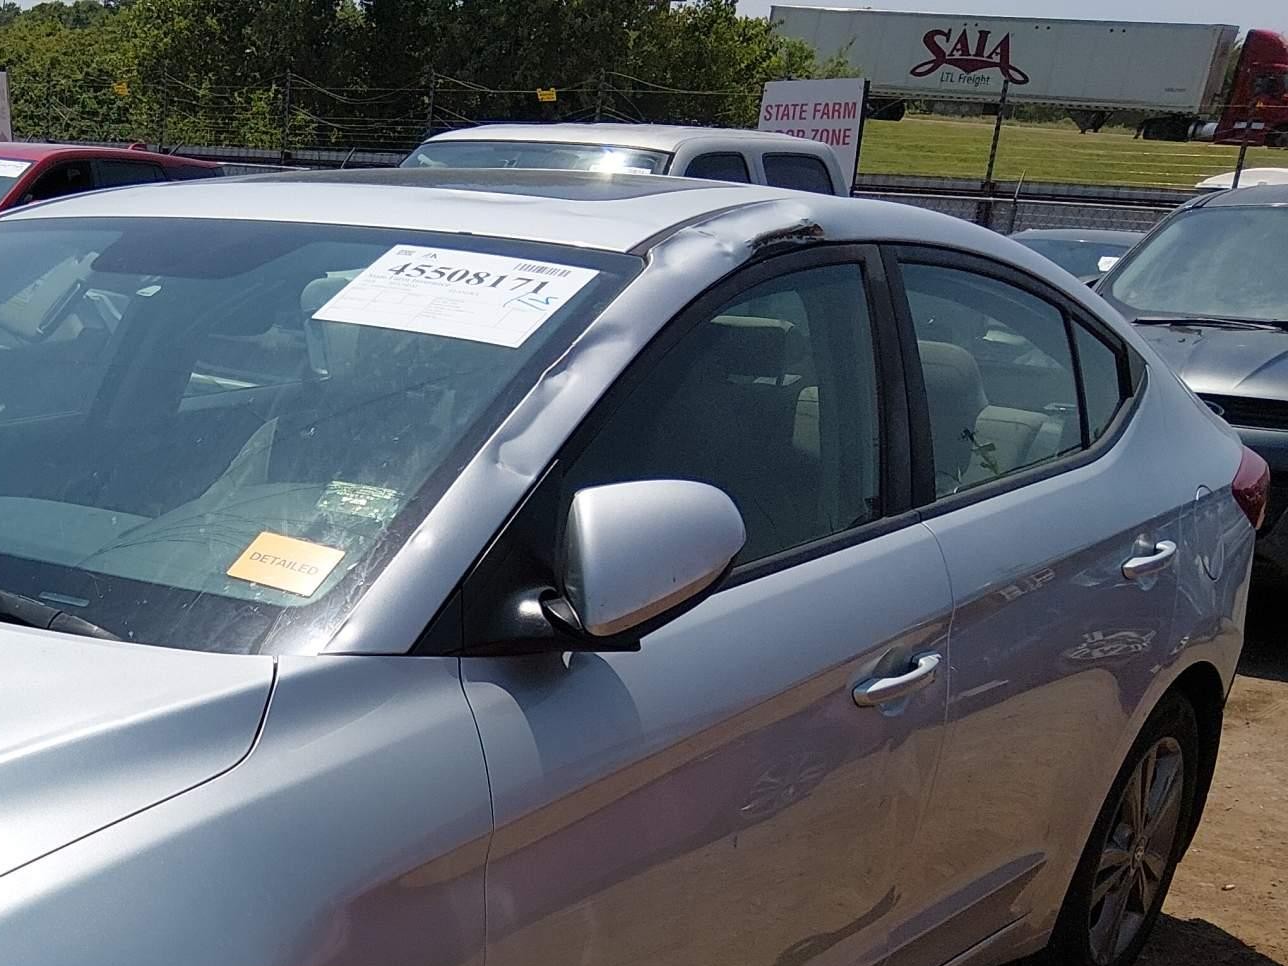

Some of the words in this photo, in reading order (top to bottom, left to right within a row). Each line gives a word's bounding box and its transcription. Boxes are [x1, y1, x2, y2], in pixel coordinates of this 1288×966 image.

[940, 72, 955, 83] LTL
[958, 73, 991, 87] Freight
[764, 103, 809, 121] STATE
[813, 101, 857, 120] FARM
[388, 262, 550, 294] 45508171
[248, 551, 319, 576] DETAILED
